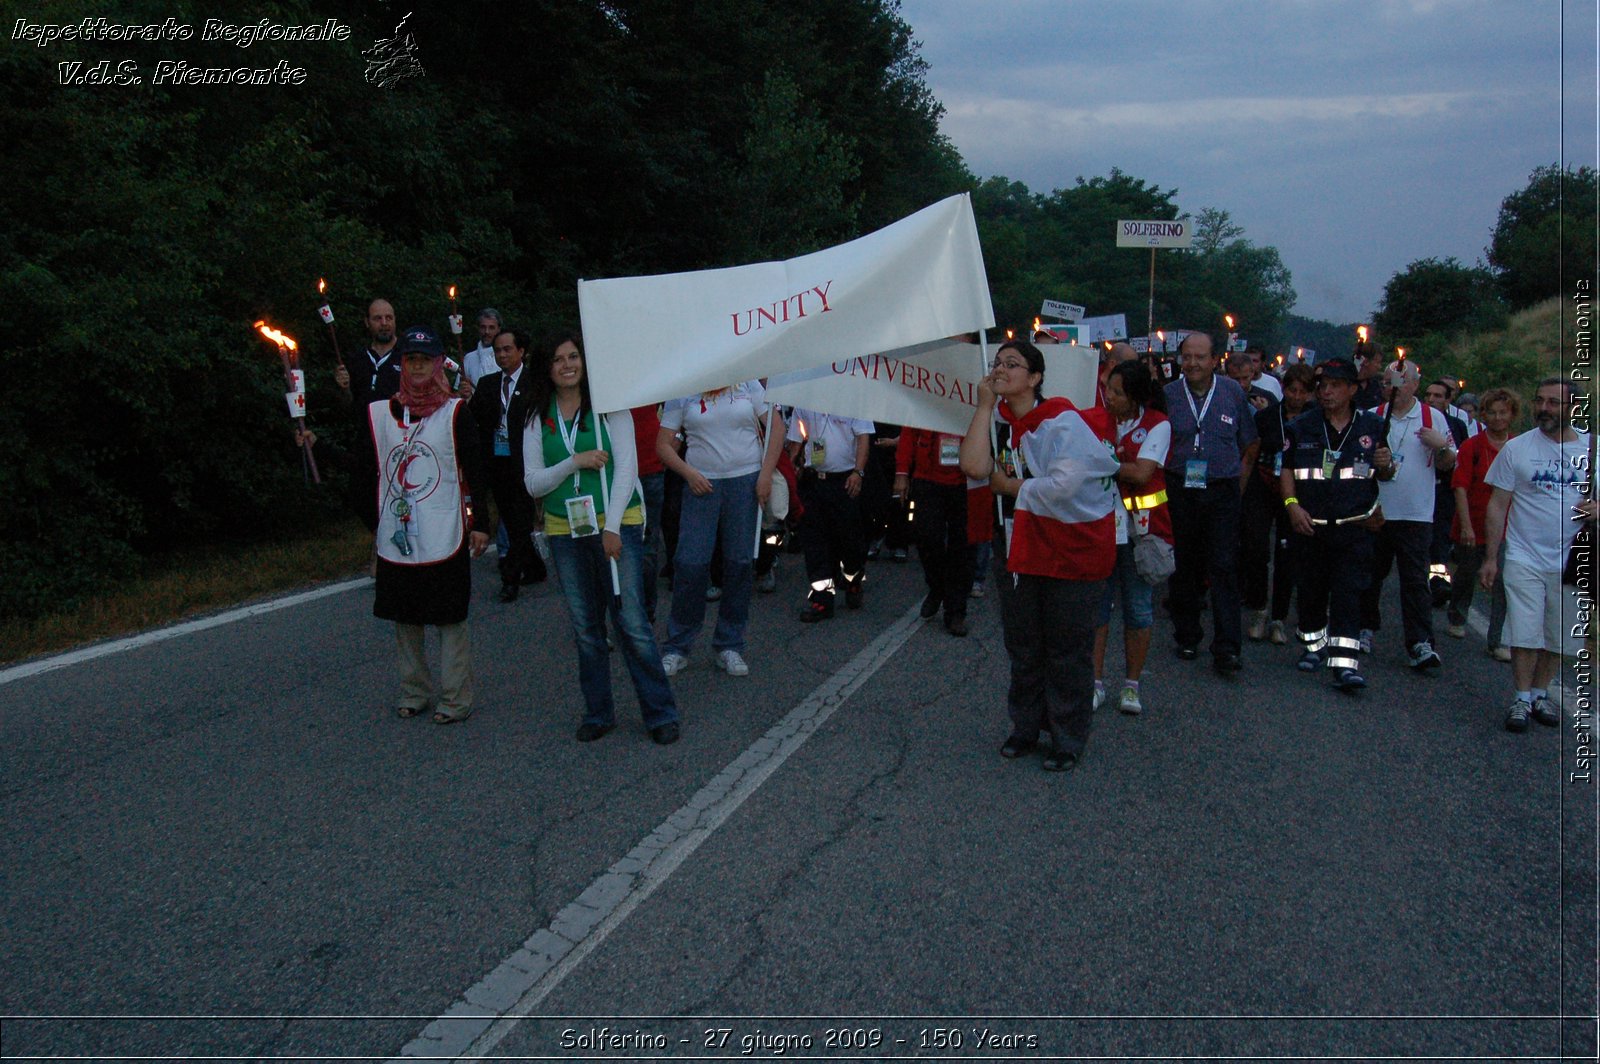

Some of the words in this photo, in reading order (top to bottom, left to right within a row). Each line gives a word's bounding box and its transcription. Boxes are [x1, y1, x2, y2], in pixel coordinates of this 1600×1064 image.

[1123, 222, 1184, 237] SOLFERINO
[731, 279, 834, 336] UNITY
[1046, 301, 1082, 313] TOLENTINO
